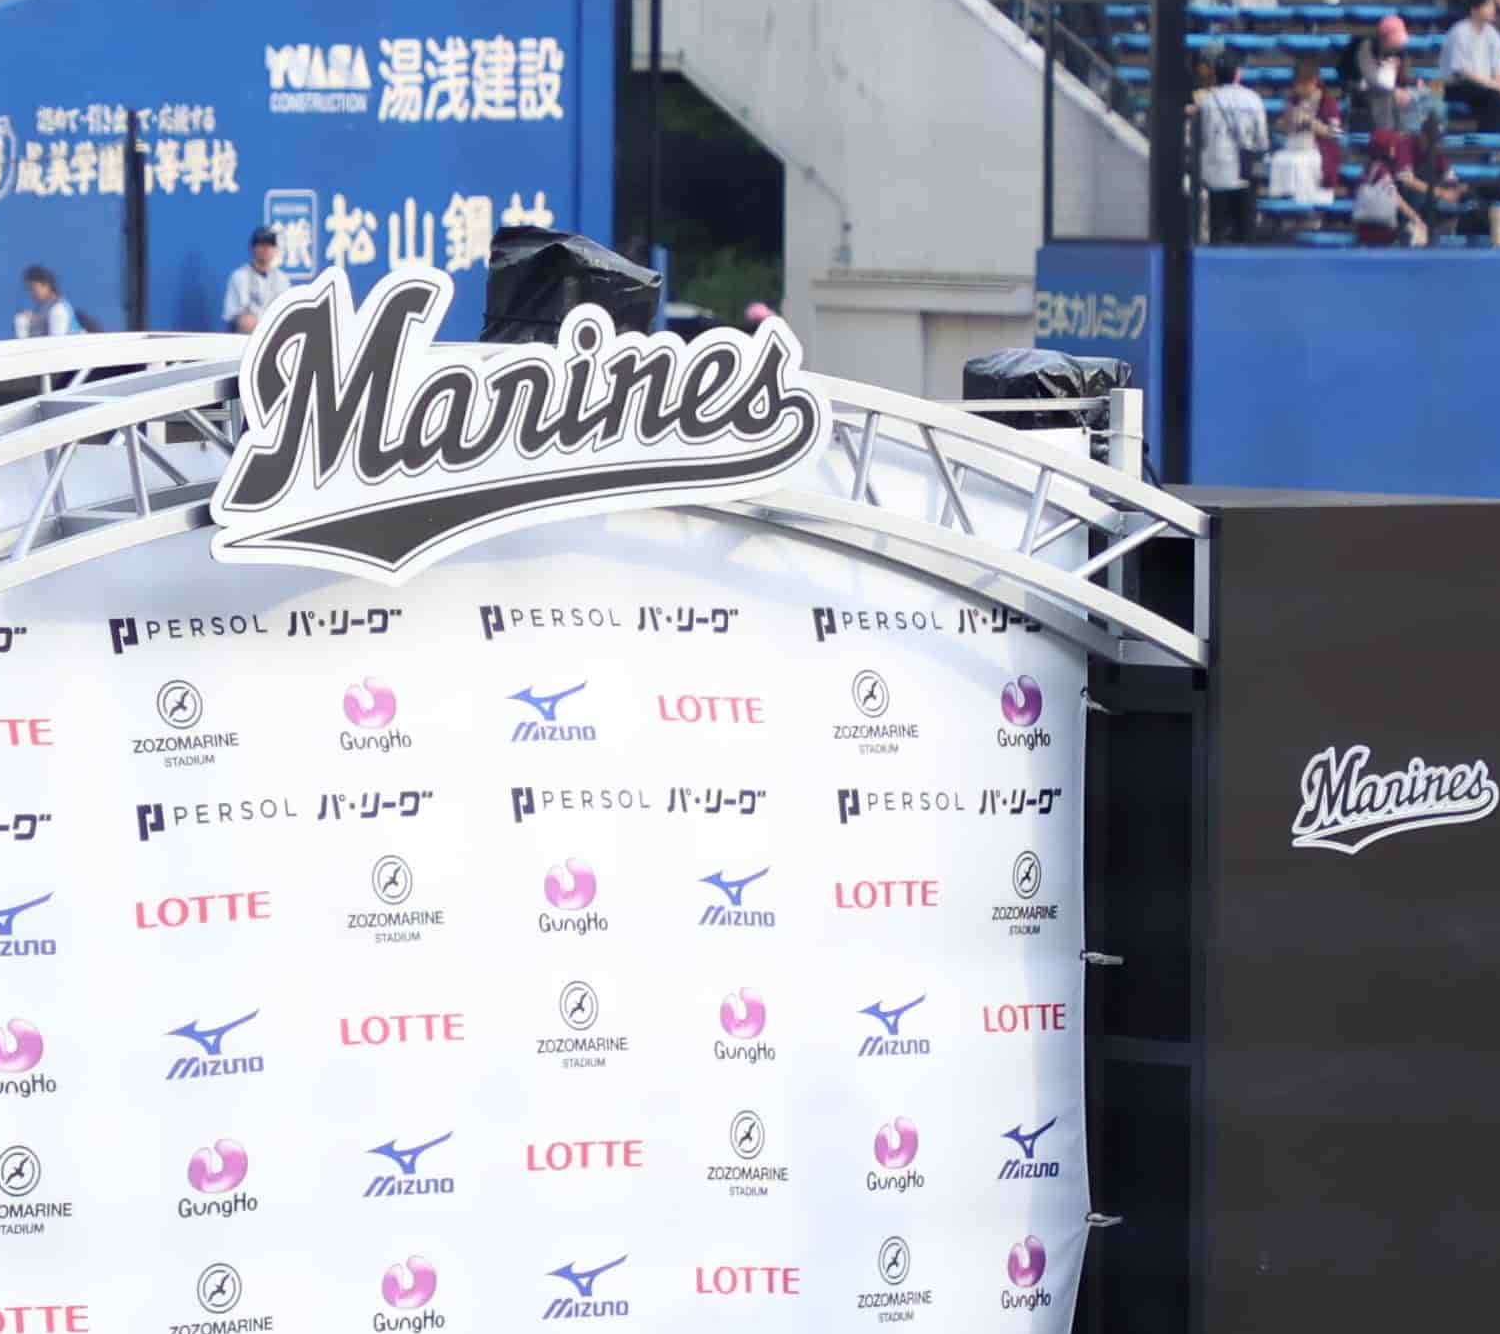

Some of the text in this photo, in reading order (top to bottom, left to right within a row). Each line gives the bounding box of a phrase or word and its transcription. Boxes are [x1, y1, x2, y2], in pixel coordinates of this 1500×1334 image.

[264, 44, 372, 90] YUASA
[378, 34, 565, 123] 湯浅建設
[220, 269, 818, 522] Marines
[146, 613, 267, 640] PERSOL
[511, 607, 621, 629] PERSOL
[842, 609, 944, 631] PERSOL
[658, 694, 764, 723] LOTTE
[340, 731, 412, 753] GungHo
[833, 724, 919, 740] ZOZOMARINE
[996, 729, 1050, 750] GungHo
[132, 734, 238, 754] ZOZOMARINE
[164, 754, 216, 767] STADIUM
[542, 789, 651, 810] PERSOL
[867, 791, 965, 812] PERSOL
[1292, 745, 1499, 842] Marines
[173, 798, 296, 826] PERSOL
[834, 881, 938, 908] LOTTE
[135, 892, 270, 929] LOTTE
[347, 911, 444, 929] ZOZOMARINE
[992, 905, 1057, 921] ZOZOMARINE
[539, 913, 608, 934] GungHo
[374, 931, 420, 943] STADIUM
[340, 1010, 464, 1045] LOTTE
[982, 1003, 1066, 1031] LOTTE
[536, 1037, 628, 1054] ZOZOMARINE
[715, 1042, 776, 1064] GungHo
[526, 1139, 643, 1171] LOTTE
[707, 1167, 788, 1182] ZOZOMARINE
[866, 1170, 924, 1192] GungHo
[178, 1196, 258, 1218] GungHo
[696, 1266, 799, 1294] LOTTE
[857, 1290, 932, 1308] ZOZOMARINE
[1001, 1289, 1051, 1311] GungHo
[373, 1310, 445, 1334] GungHo
